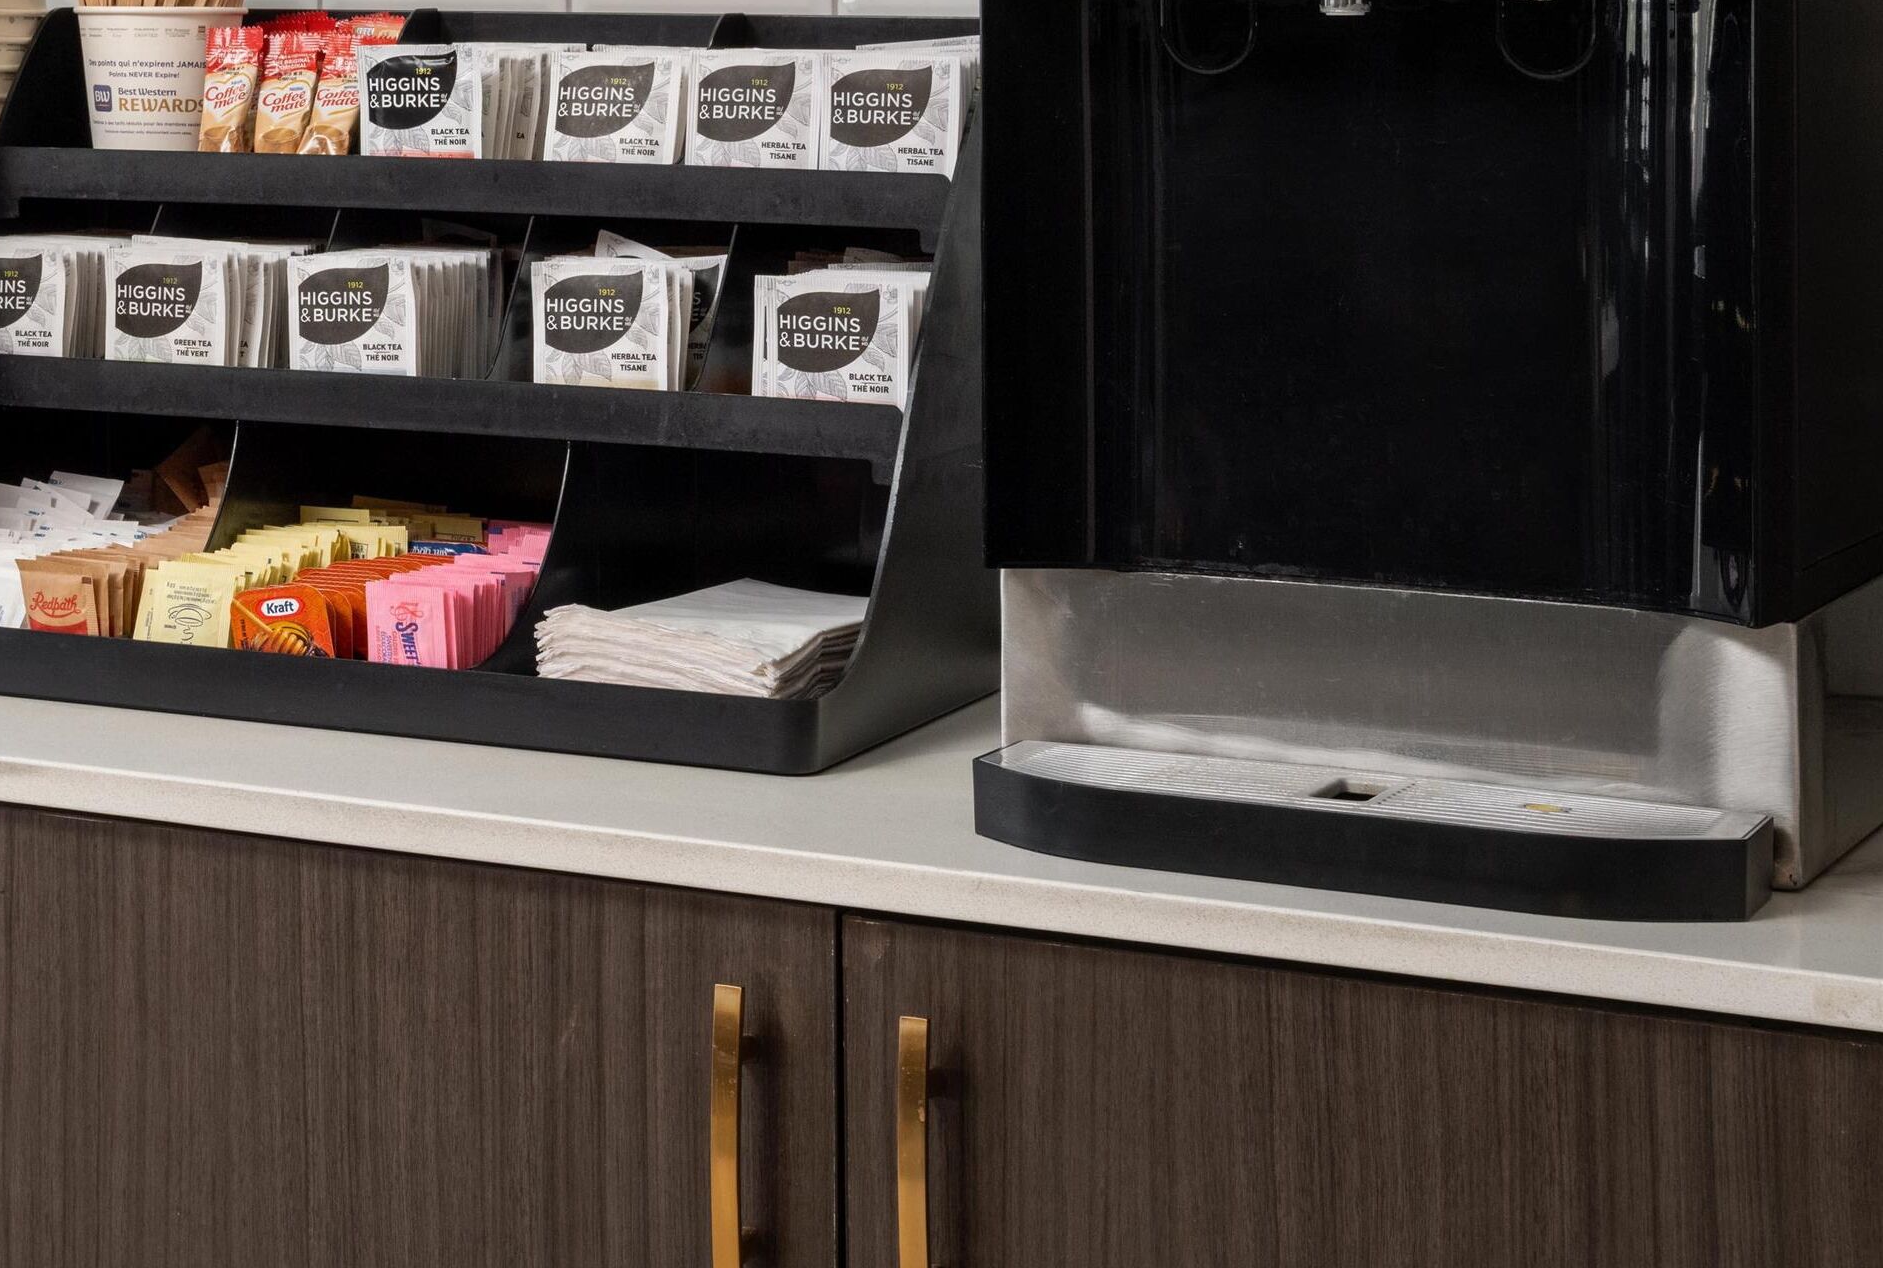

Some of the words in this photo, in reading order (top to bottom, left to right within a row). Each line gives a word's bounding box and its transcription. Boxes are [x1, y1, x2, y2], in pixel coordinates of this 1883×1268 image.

[118, 60, 131, 69] qui
[132, 60, 174, 69] n'expirent
[415, 67, 432, 75] 1912
[369, 77, 441, 92] HIGGINS
[751, 78, 768, 87] 1912
[886, 83, 903, 91] 1912
[95, 90, 111, 103] BW
[118, 87, 136, 96] Best
[138, 88, 177, 96] Western
[205, 83, 246, 102] Coffee
[559, 86, 634, 101] HIGGINS
[700, 88, 776, 103] HIGGINS
[214, 92, 246, 109] mate
[262, 90, 306, 107] Coffee
[321, 96, 359, 107] mate
[833, 91, 913, 108] HIGGINS
[270, 98, 307, 113] mate
[434, 138, 448, 146] THÉ
[619, 137, 643, 145] BLACK
[645, 138, 660, 146] TEA
[761, 141, 791, 150] HERBAL
[792, 142, 807, 151] TEA
[621, 147, 636, 156] THÉ
[637, 148, 656, 156] NOIR
[769, 152, 797, 161] TISANE
[898, 147, 928, 155] HERBAL
[929, 148, 944, 156] TEA
[906, 158, 934, 166] TISANE
[347, 281, 364, 289] 1912
[117, 284, 186, 302] HIGGINS
[598, 288, 616, 297] 1912
[300, 291, 372, 306] HIGGINS
[546, 298, 624, 314] HIGGINS
[833, 306, 851, 315] 1912
[779, 314, 861, 333] HIGGINS
[17, 338, 30, 347] THÉ
[32, 340, 49, 348] NOIR
[173, 339, 197, 347] GREEN
[362, 343, 386, 351] BLACK
[176, 348, 189, 357] THÉ
[190, 350, 209, 358] VERT
[366, 352, 380, 362] THÉ
[381, 354, 399, 362] NOIR
[611, 353, 641, 361] HERBAL
[641, 353, 657, 361] TEA
[620, 363, 647, 372] TISANE
[849, 373, 875, 382] BLACK
[851, 384, 868, 393] THÉ
[869, 385, 889, 394] NOIR
[29, 590, 81, 618] Redpath
[266, 600, 295, 615] Kraft
